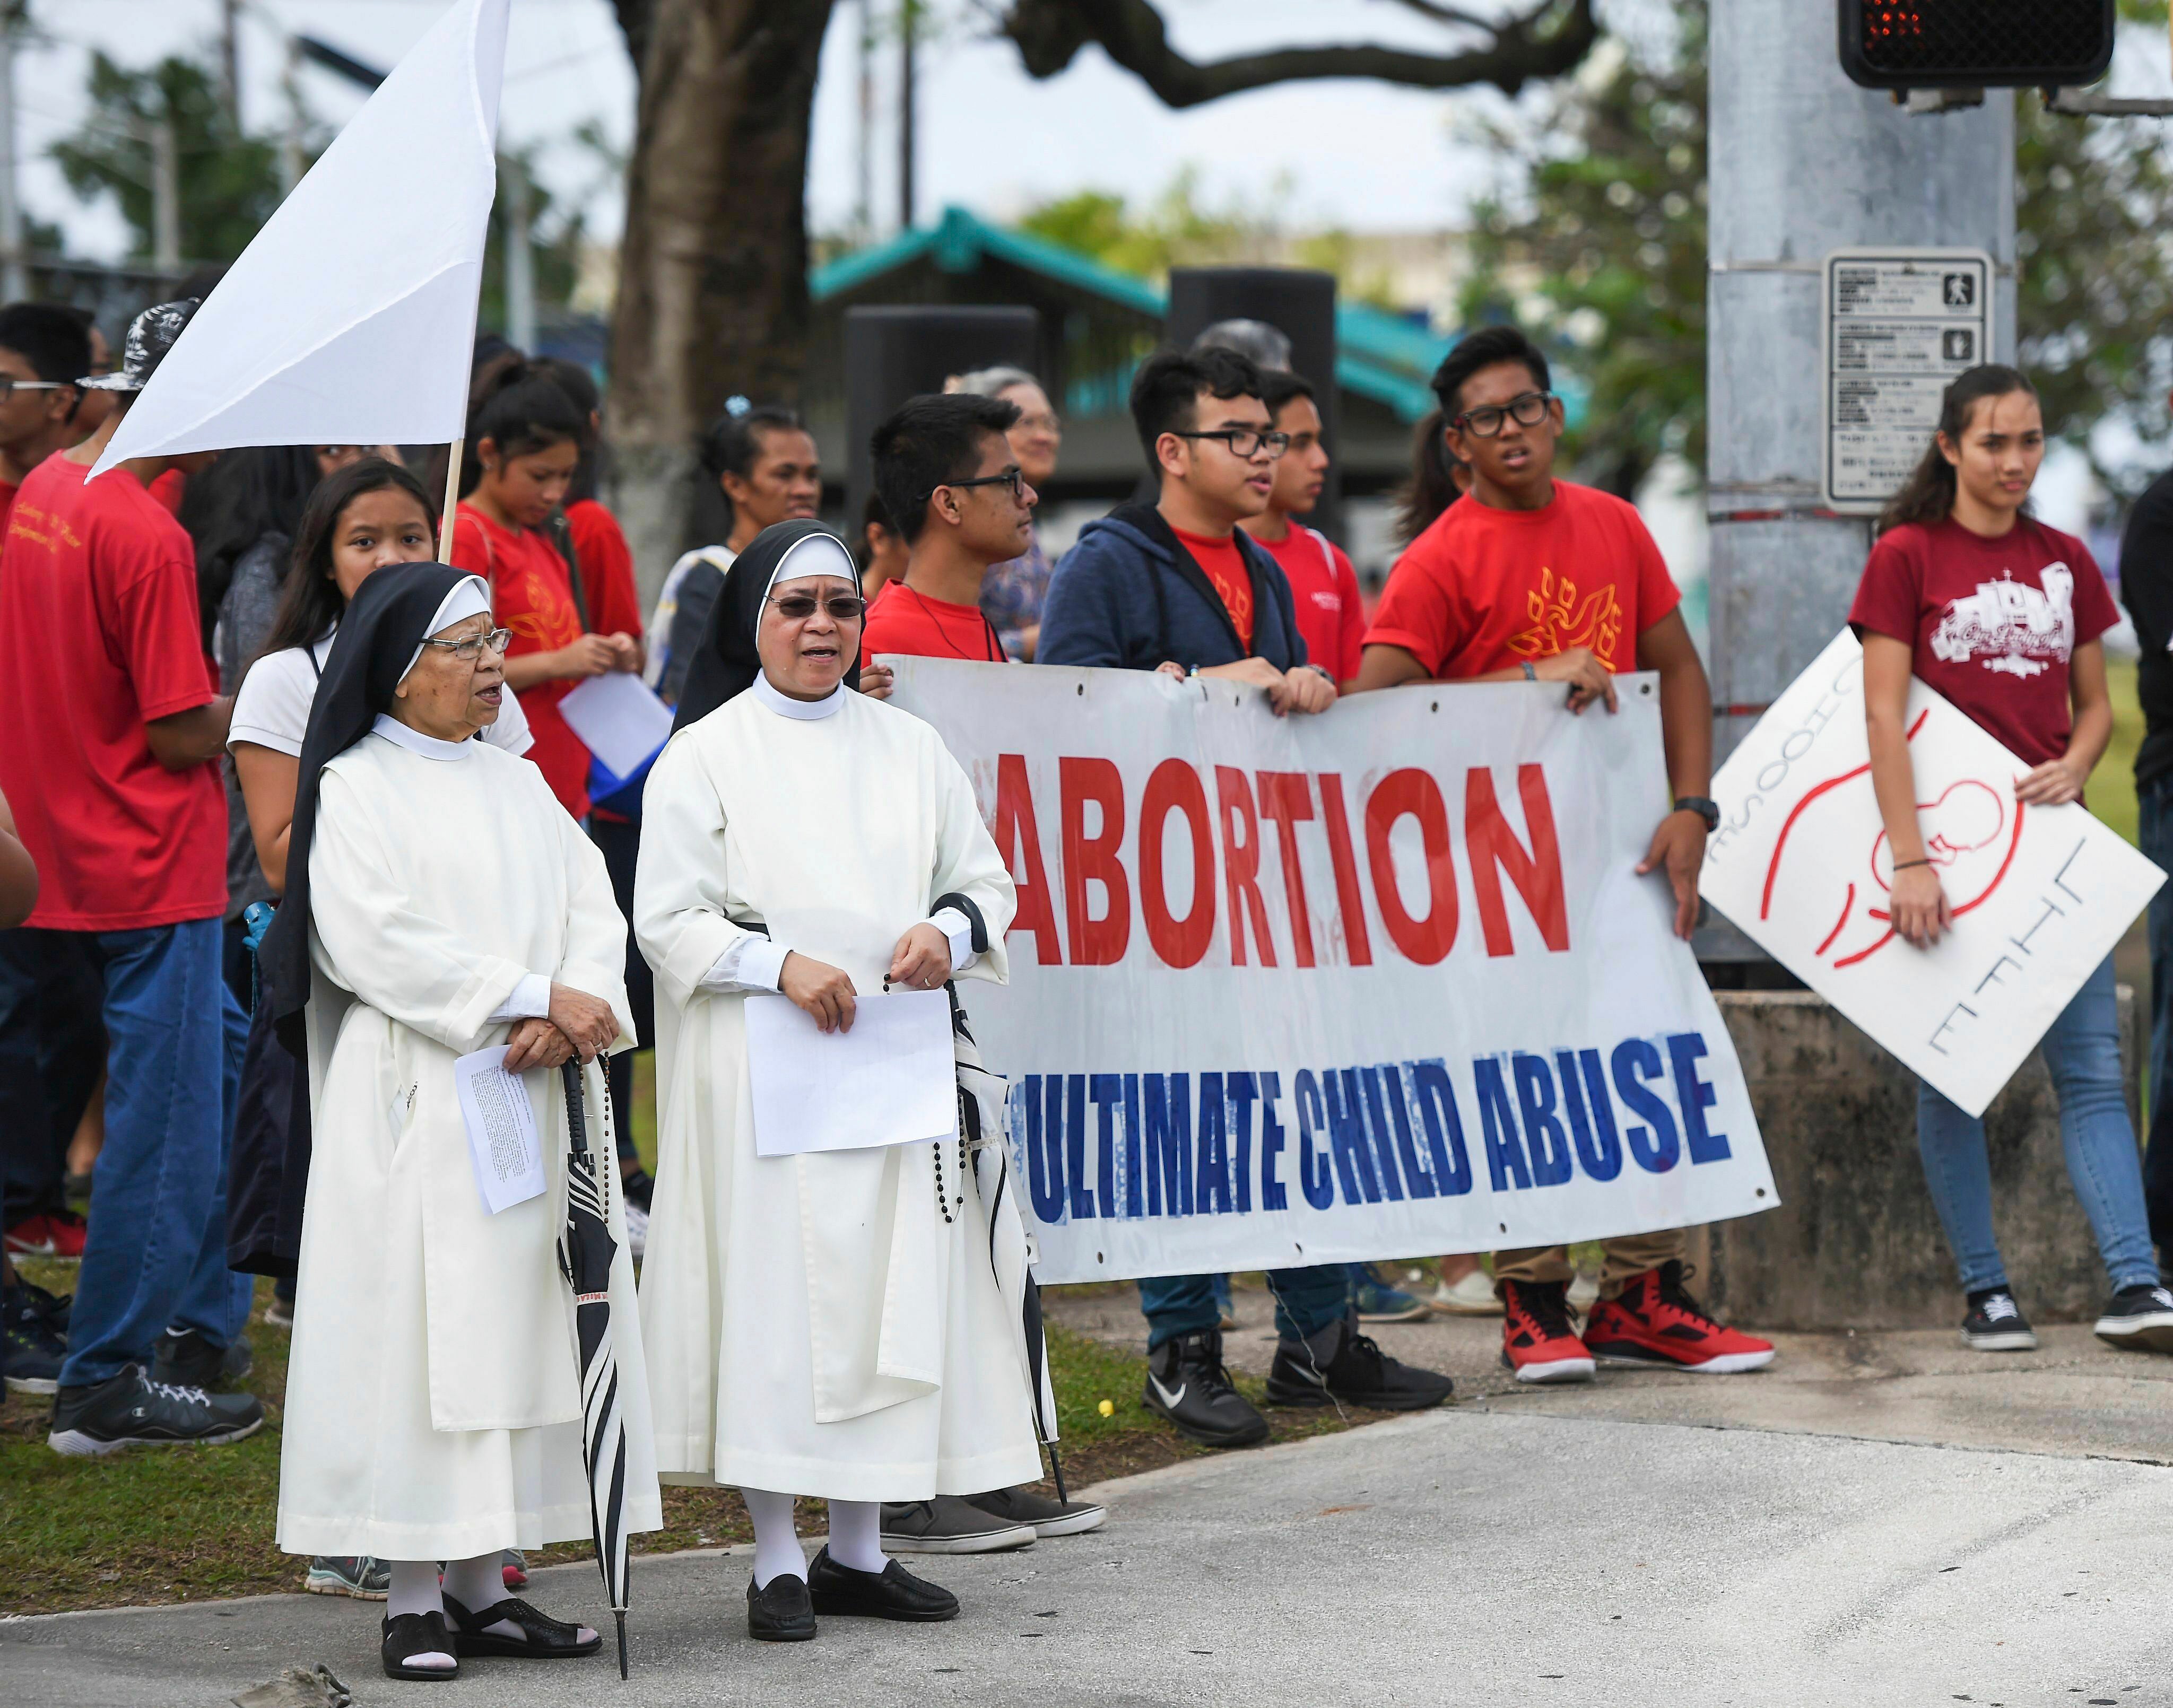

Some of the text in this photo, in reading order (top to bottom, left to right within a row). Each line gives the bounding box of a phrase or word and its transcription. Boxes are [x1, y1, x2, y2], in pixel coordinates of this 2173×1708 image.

[995, 754, 1570, 969] ABORTION
[1928, 836, 2087, 1057] LIFE
[1025, 1071, 1288, 1223] ULTIMATE
[1295, 1060, 1472, 1210] CHILD
[1474, 1032, 1732, 1192] ABUSE
